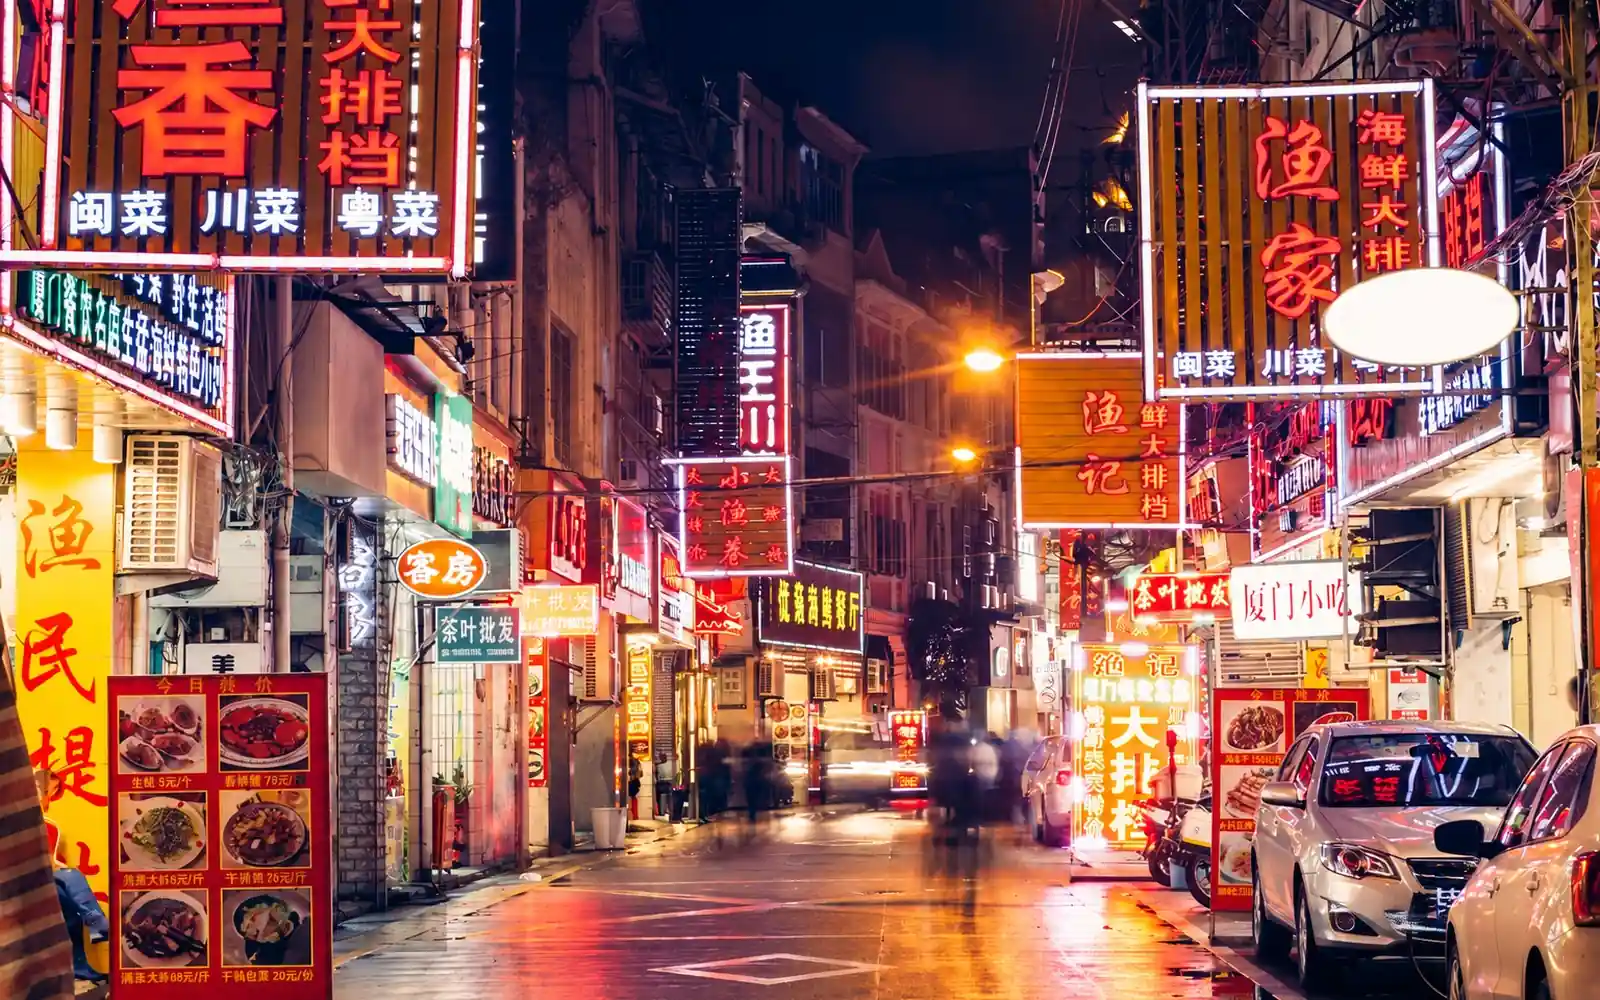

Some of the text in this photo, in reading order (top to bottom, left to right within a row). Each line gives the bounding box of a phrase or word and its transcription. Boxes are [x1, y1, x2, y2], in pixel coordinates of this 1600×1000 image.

[111, 0, 278, 177] 香
[318, 0, 402, 187] 大排档
[69, 188, 440, 237] 闽菜 川菜 粤菜
[1255, 116, 1342, 317] 渔家
[1357, 110, 1411, 270] 海鲜大排
[740, 313, 777, 456] 渔王川
[1173, 350, 1235, 378] 闽菜
[1261, 348, 1326, 376] 川菜
[1077, 391, 1129, 494] 渔记
[1140, 403, 1169, 520] 鲜大排档
[403, 550, 478, 586] 客房
[1134, 577, 1229, 610] 茶叶批发
[1244, 578, 1353, 622] 厦门小吃
[441, 616, 515, 644] 茶叶批发
